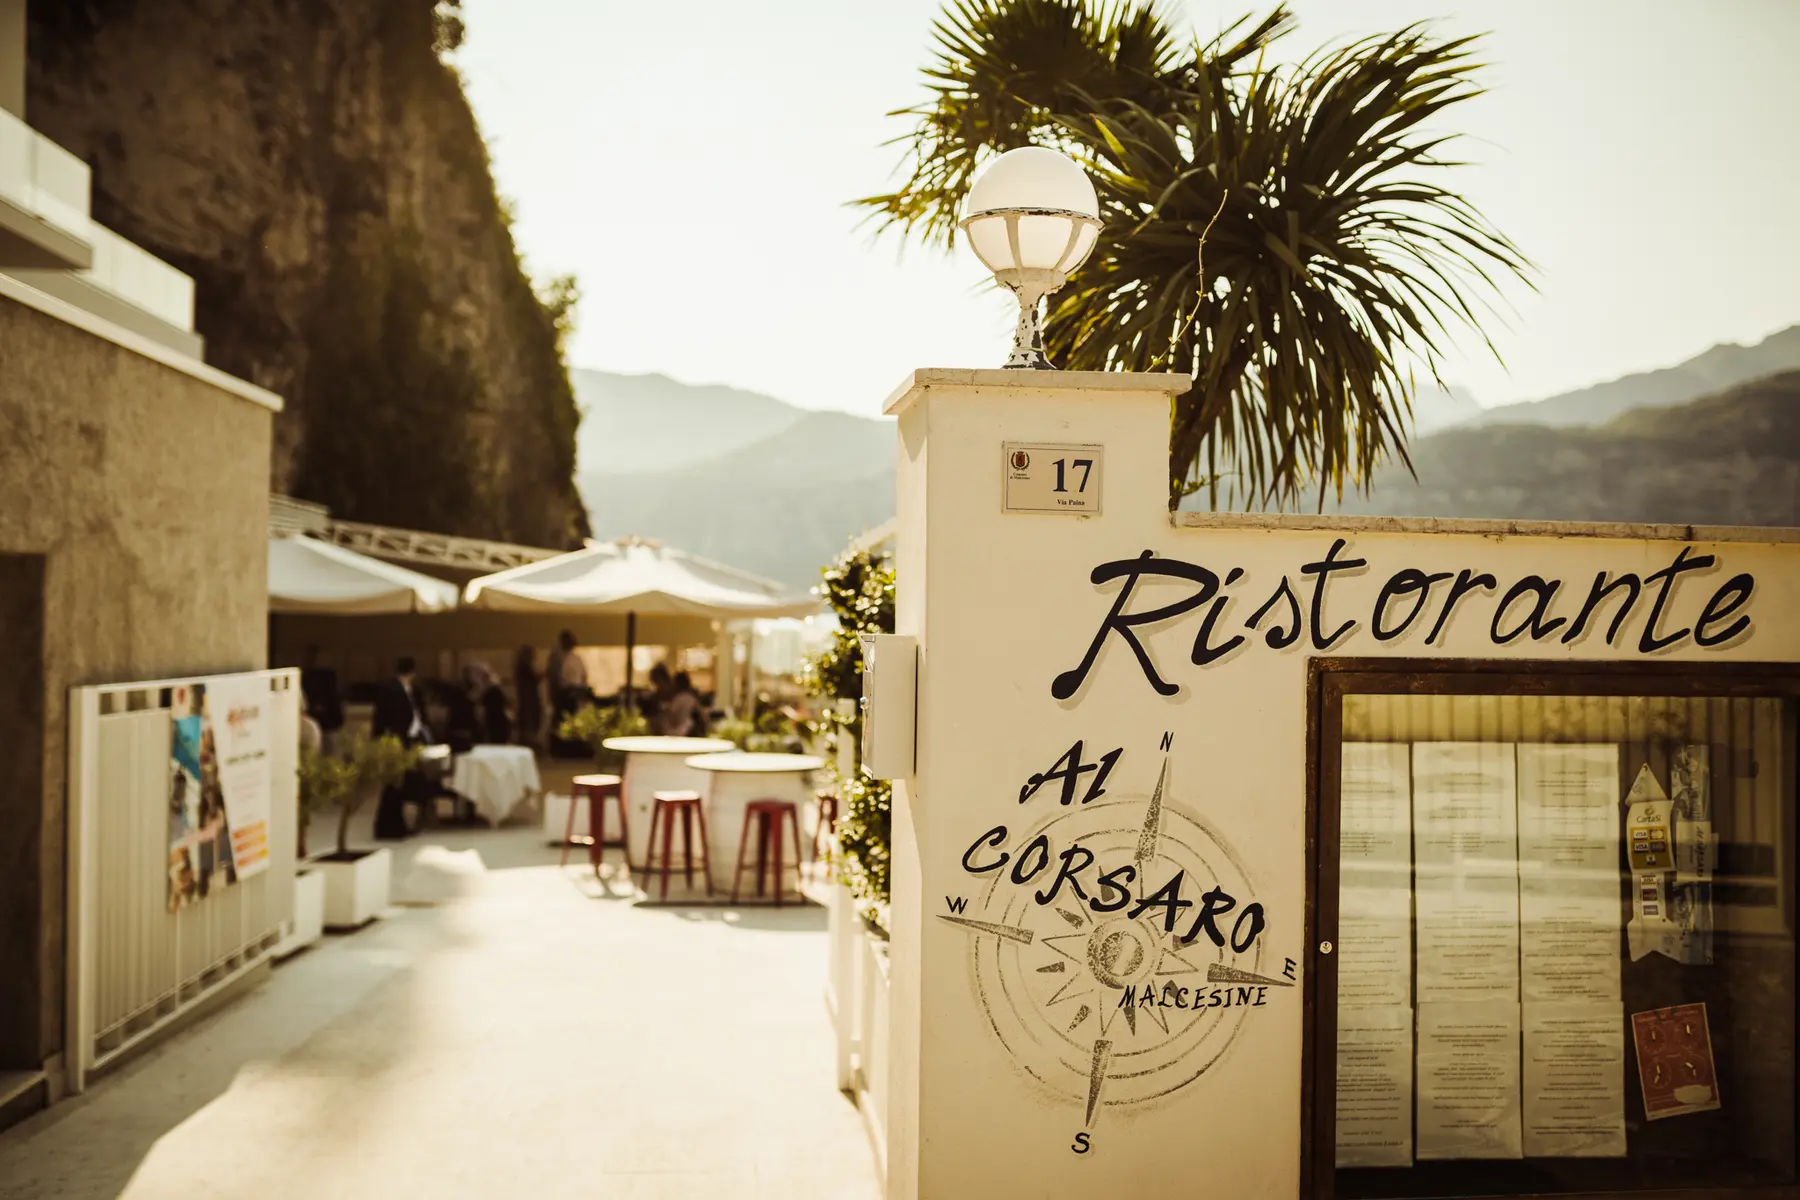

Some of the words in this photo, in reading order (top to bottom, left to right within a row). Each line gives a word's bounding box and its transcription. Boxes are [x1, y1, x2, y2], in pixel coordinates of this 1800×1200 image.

[1052, 458, 1093, 493] 17
[1051, 538, 1756, 700] Ristorante
[1159, 731, 1174, 752] N
[1018, 739, 1124, 806] Al
[961, 825, 1266, 954] CORSARO
[945, 895, 969, 915] W
[1282, 957, 1297, 981] E
[1117, 984, 1269, 1011] MALCESINE
[1070, 1132, 1091, 1155] S
